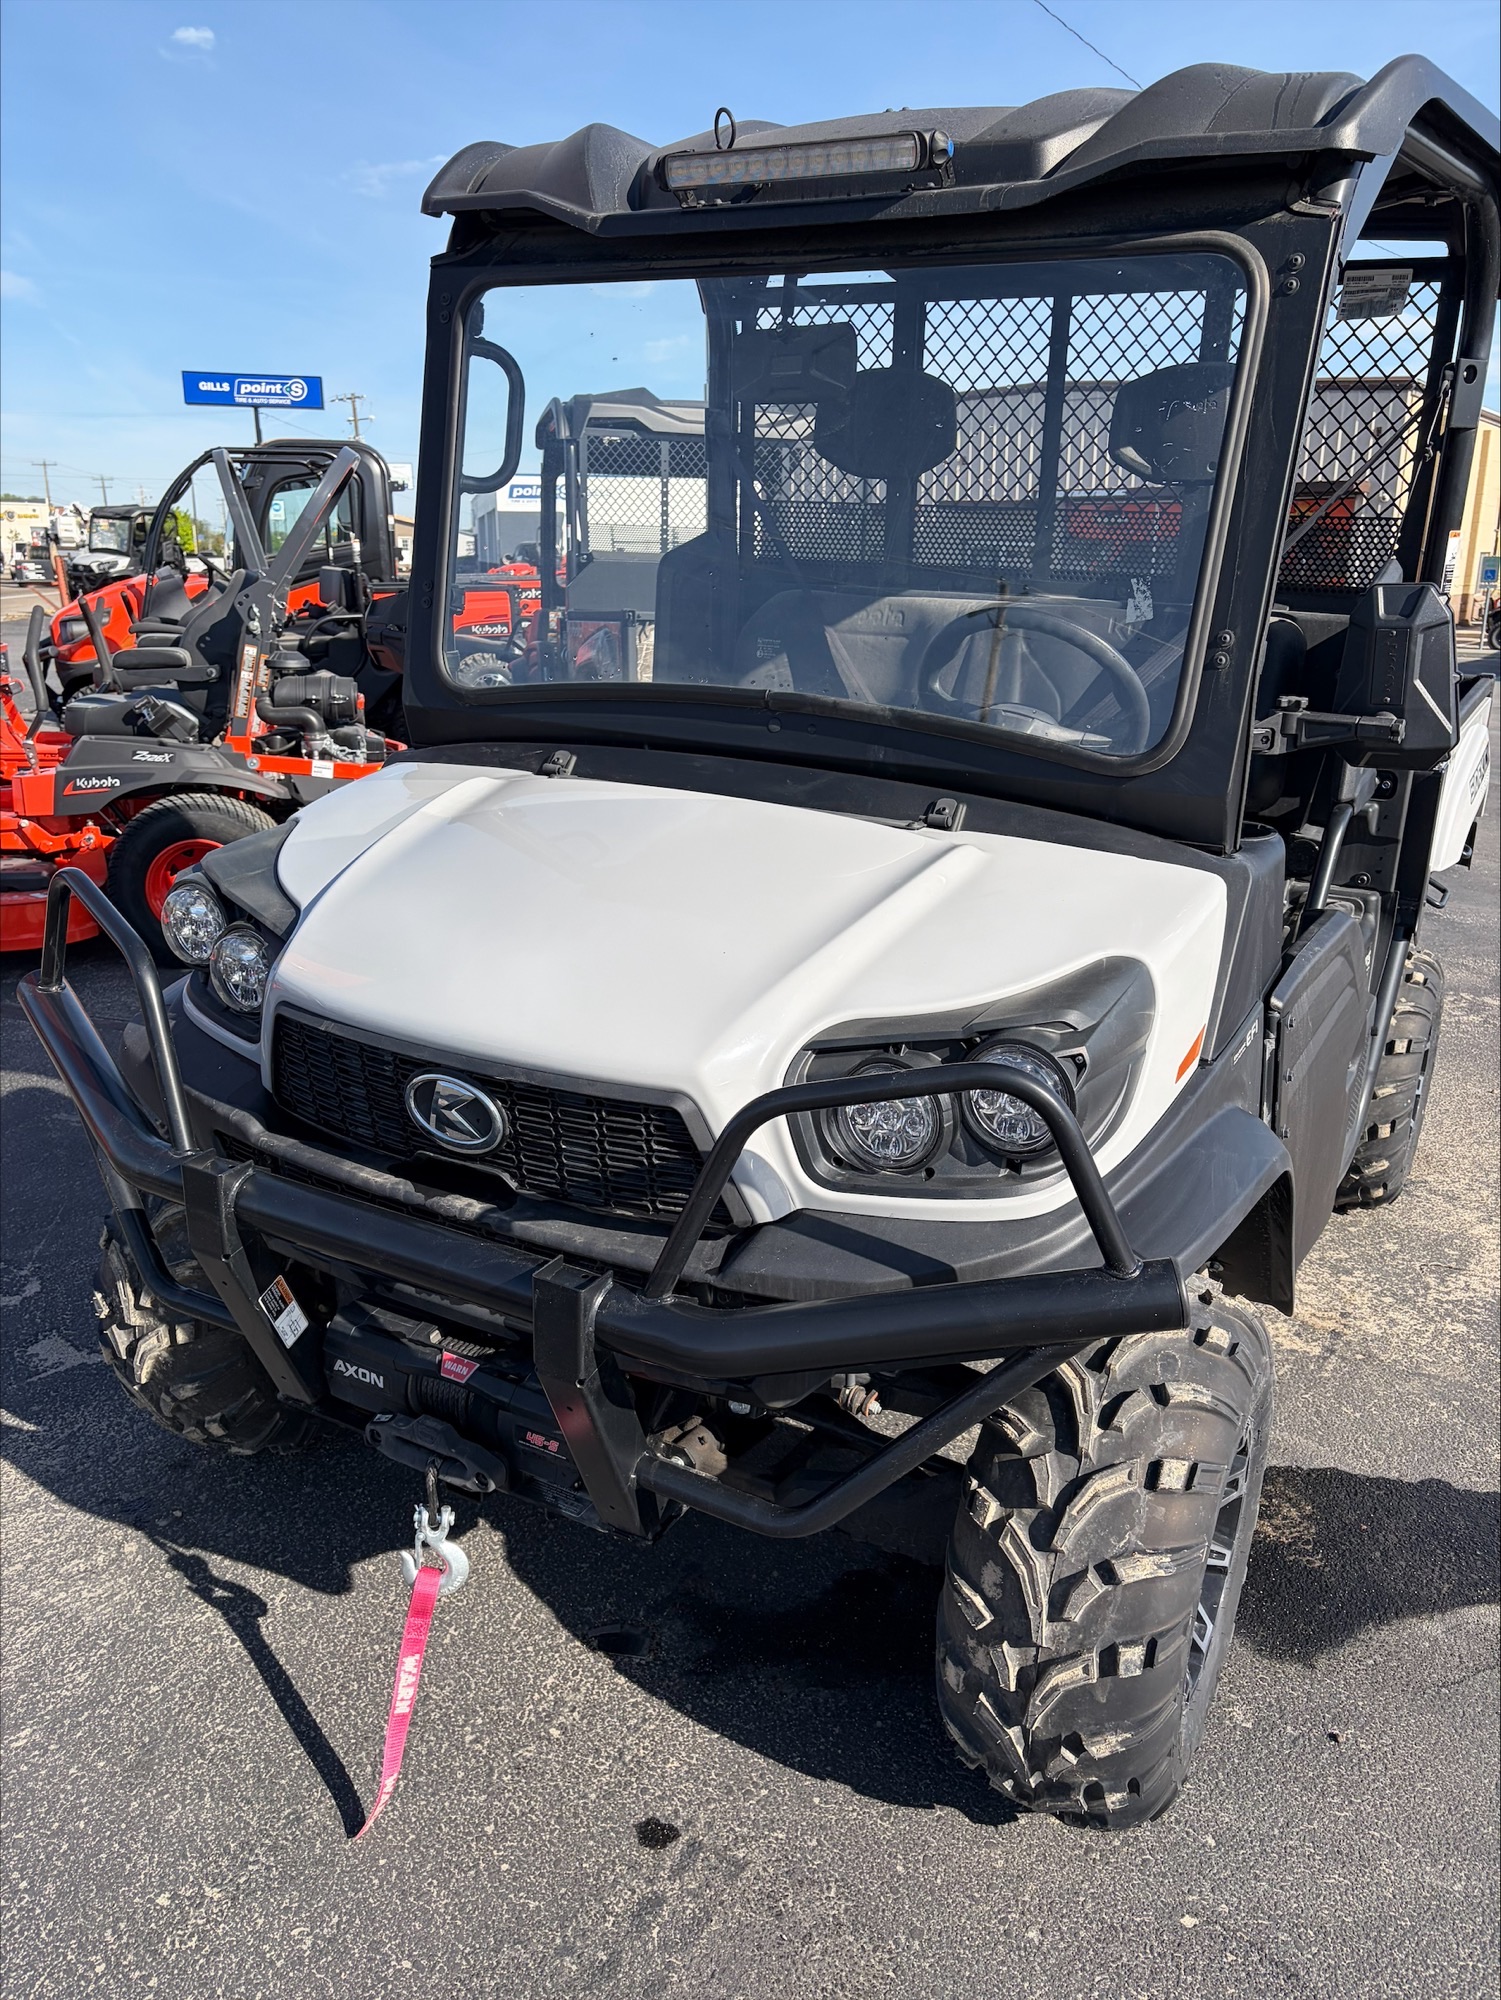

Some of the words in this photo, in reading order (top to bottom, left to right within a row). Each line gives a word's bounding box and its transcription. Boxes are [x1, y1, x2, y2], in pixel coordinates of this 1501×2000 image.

[199, 382, 230, 391] GILLS
[240, 383, 282, 394] point
[290, 384, 305, 396] S
[471, 624, 508, 635] Kubota
[132, 751, 174, 763] Z726X
[76, 776, 121, 788] Kubota
[1246, 1019, 1259, 1047] EFI
[333, 1359, 384, 1389] AXON
[444, 1360, 469, 1375] WARN
[394, 1654, 420, 1714] WARN
